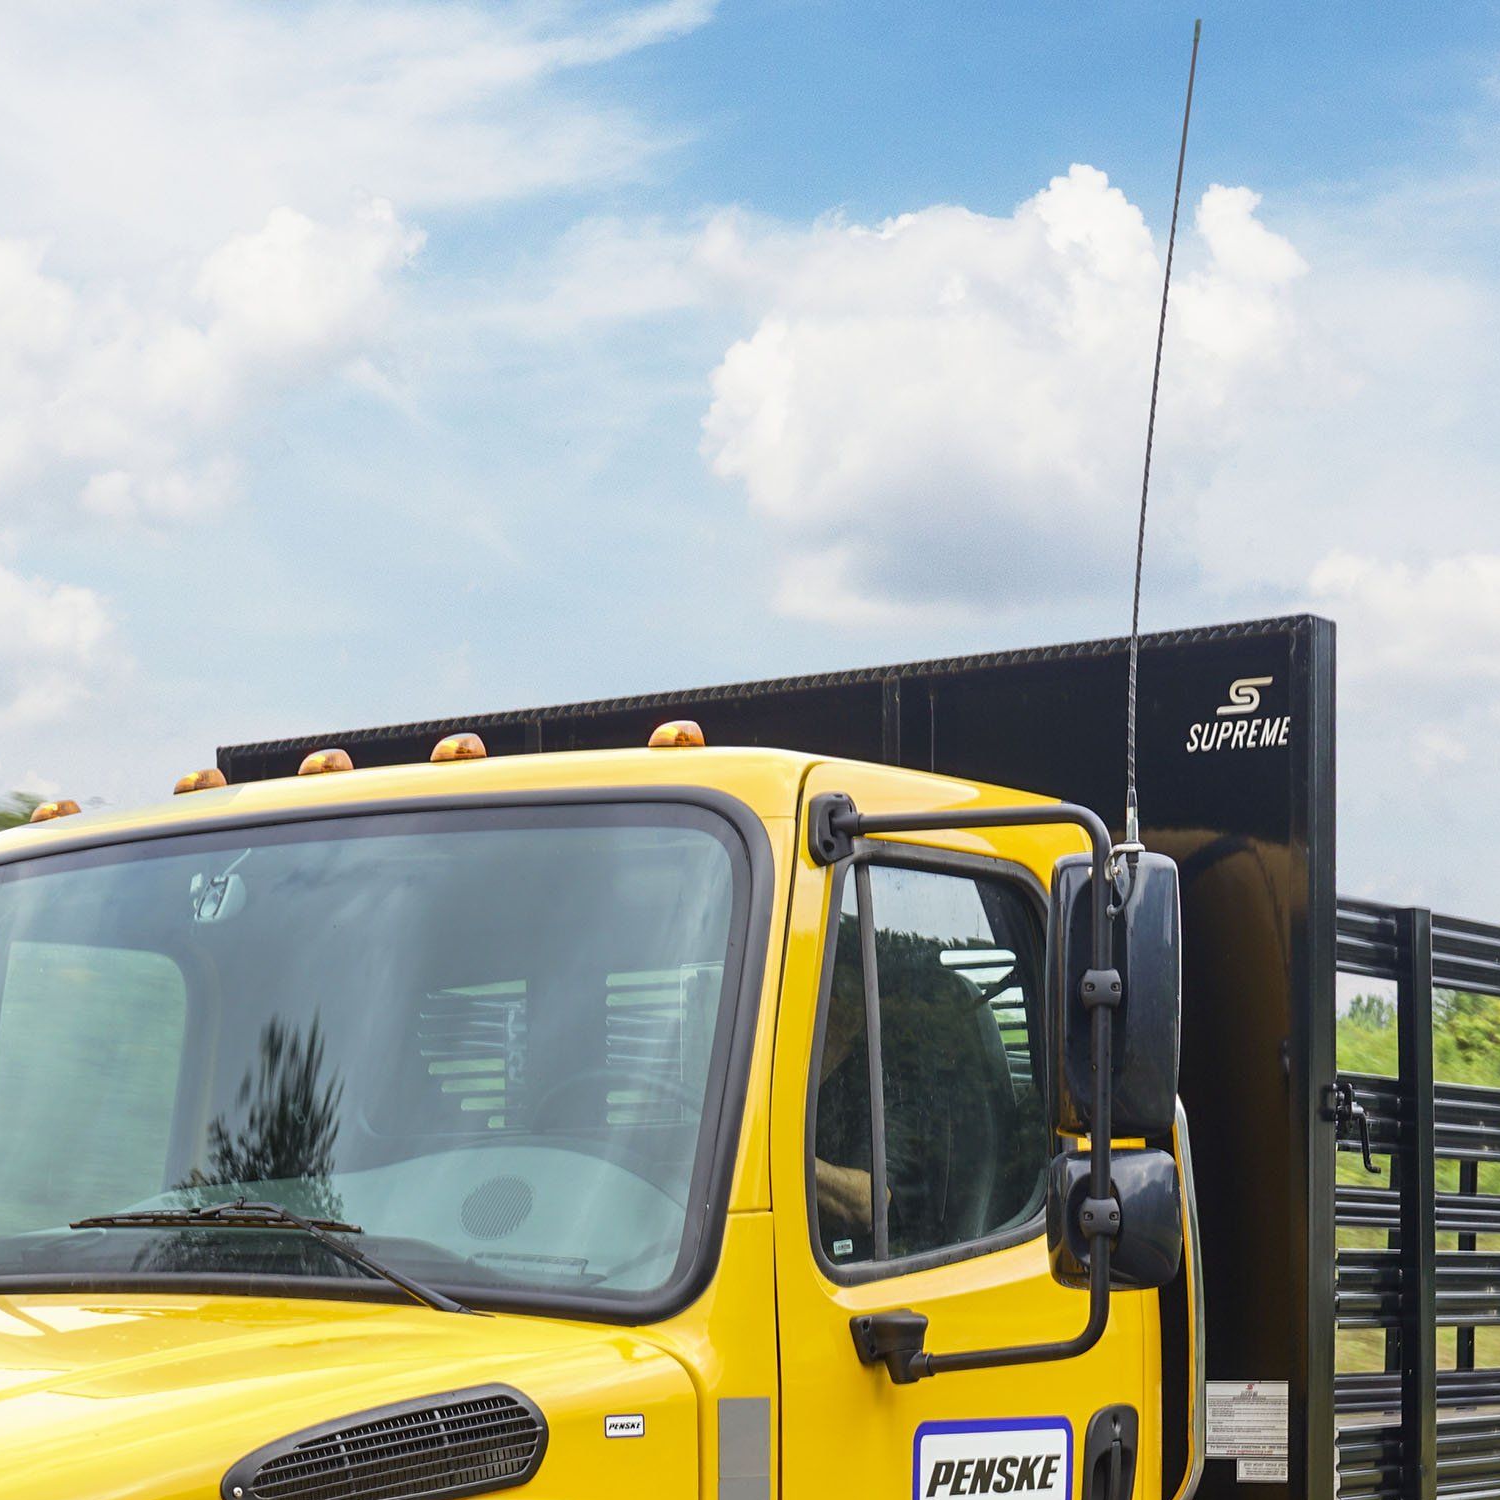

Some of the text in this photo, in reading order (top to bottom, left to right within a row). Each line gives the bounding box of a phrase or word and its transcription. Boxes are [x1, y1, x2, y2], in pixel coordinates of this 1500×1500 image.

[1186, 716, 1291, 753] SUPREME
[608, 1421, 642, 1430] PENSKE
[926, 1453, 1062, 1498] PENSKE
